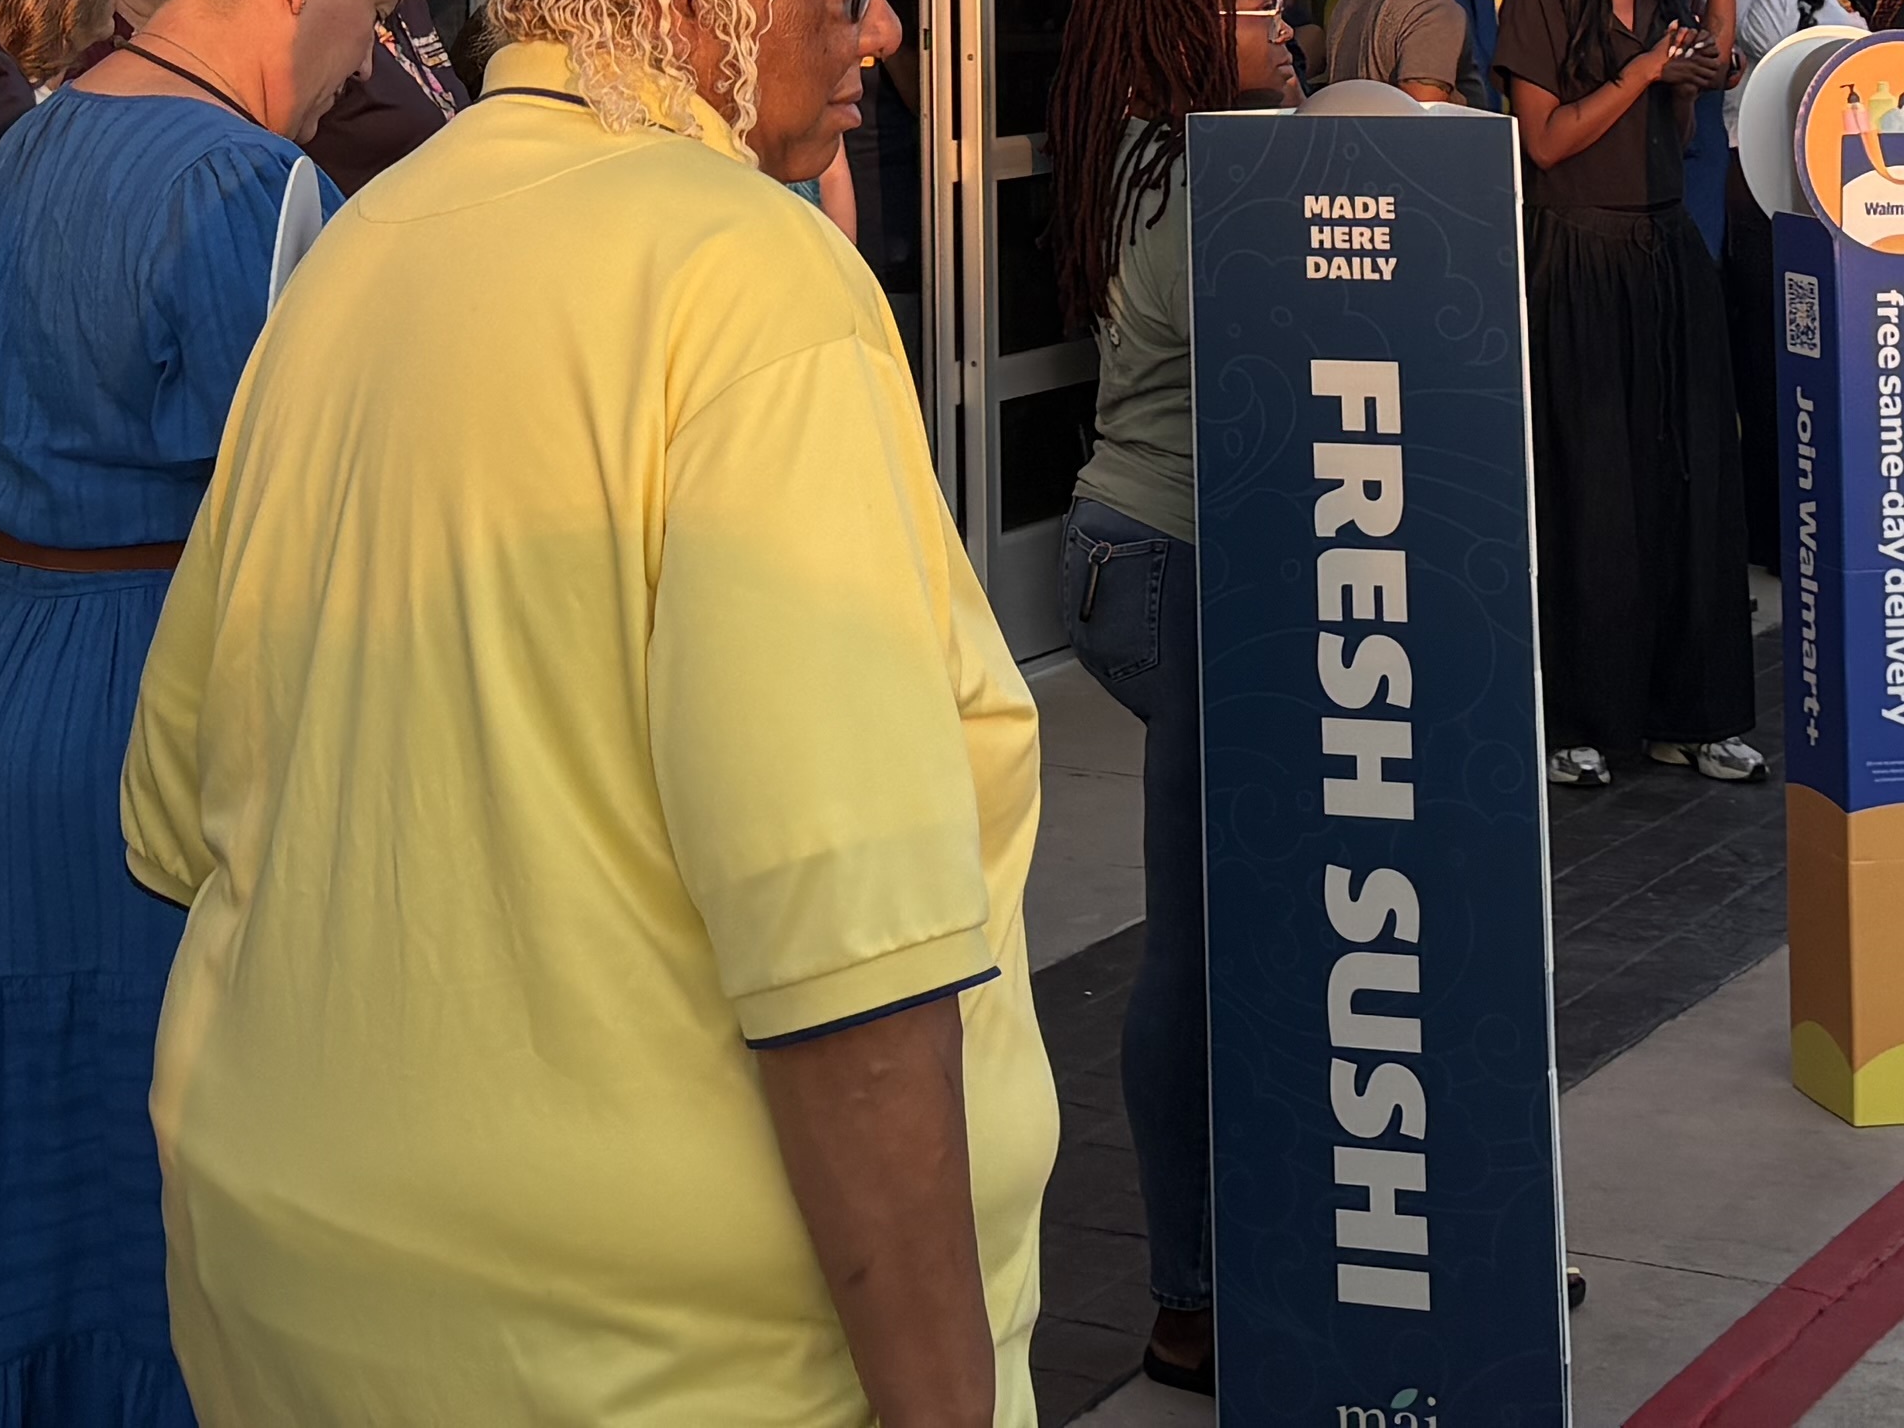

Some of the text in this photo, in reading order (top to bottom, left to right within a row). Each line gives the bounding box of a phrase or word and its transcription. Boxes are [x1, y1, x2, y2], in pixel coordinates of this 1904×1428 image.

[1304, 195, 1396, 220] MADE
[1310, 226, 1391, 250] HERE
[1306, 256, 1397, 280] DAILY
[1876, 289, 1904, 370] free
[1796, 385, 1820, 746] Join Walmart+
[1310, 359, 1431, 1312] FRESH SUSHI
